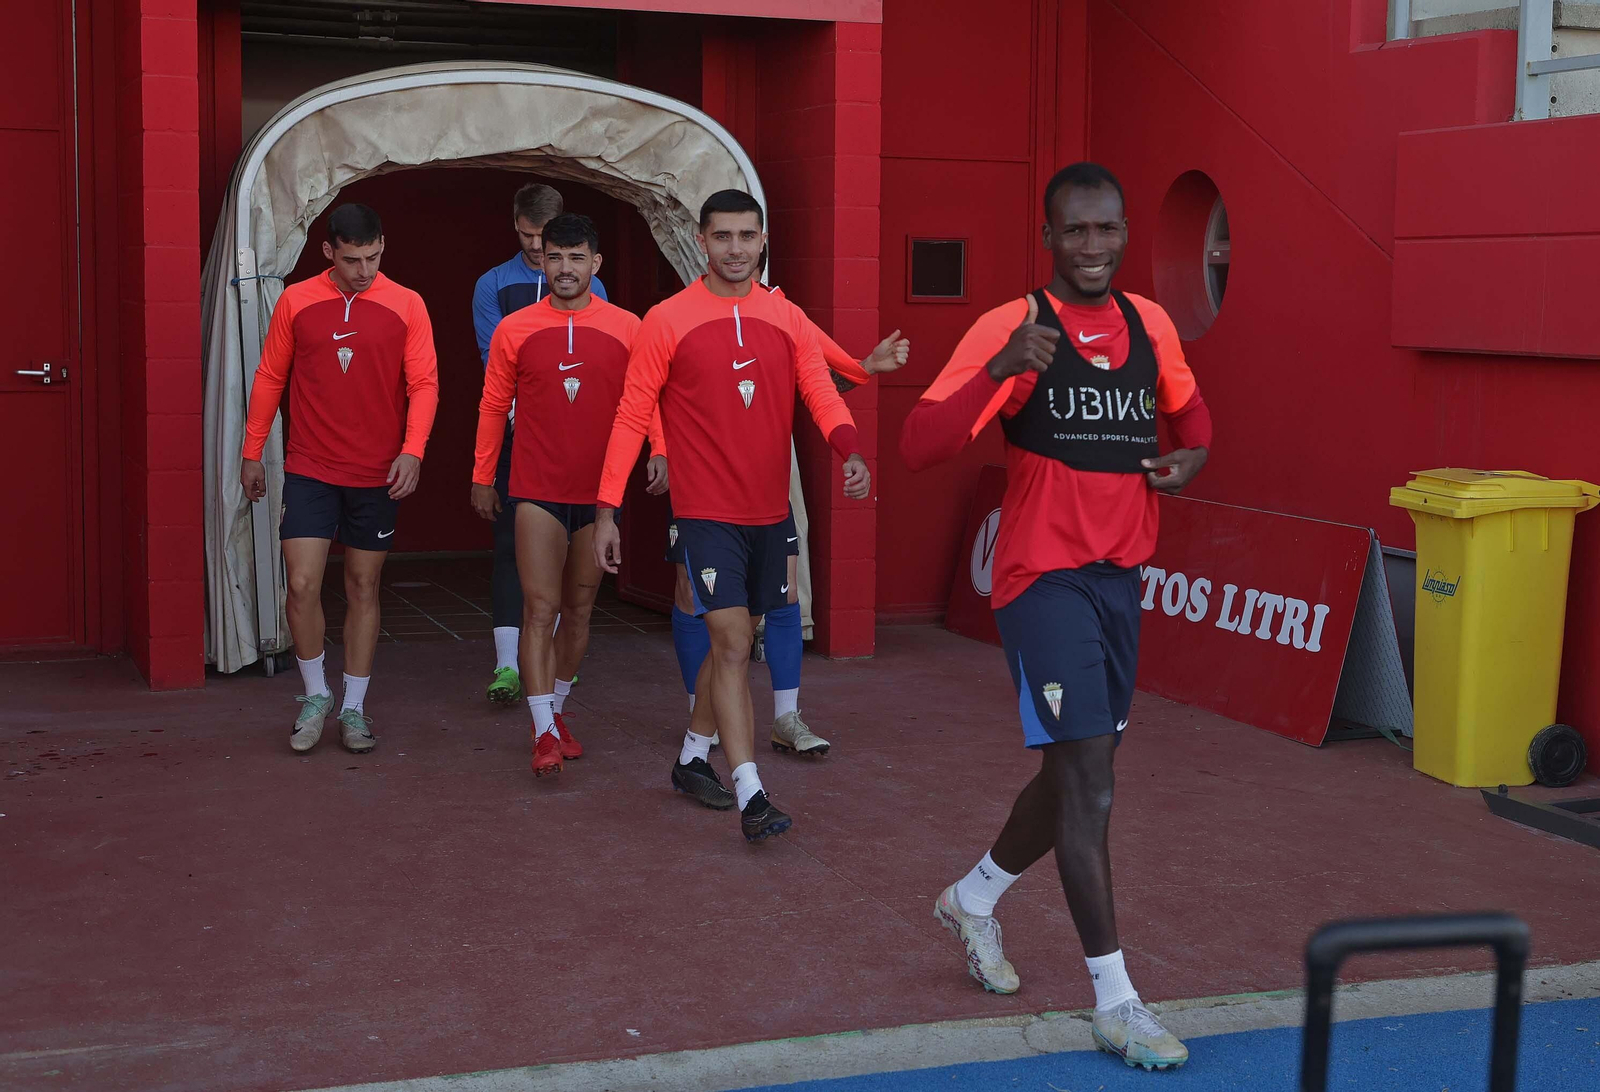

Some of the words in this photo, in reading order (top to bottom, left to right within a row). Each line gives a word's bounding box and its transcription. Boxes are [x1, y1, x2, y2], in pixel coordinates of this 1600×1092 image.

[1053, 432, 1099, 441] ADVANCED
[1101, 433, 1129, 442] SPORTS
[1139, 564, 1212, 622] TOS
[1215, 583, 1330, 652] LITRI
